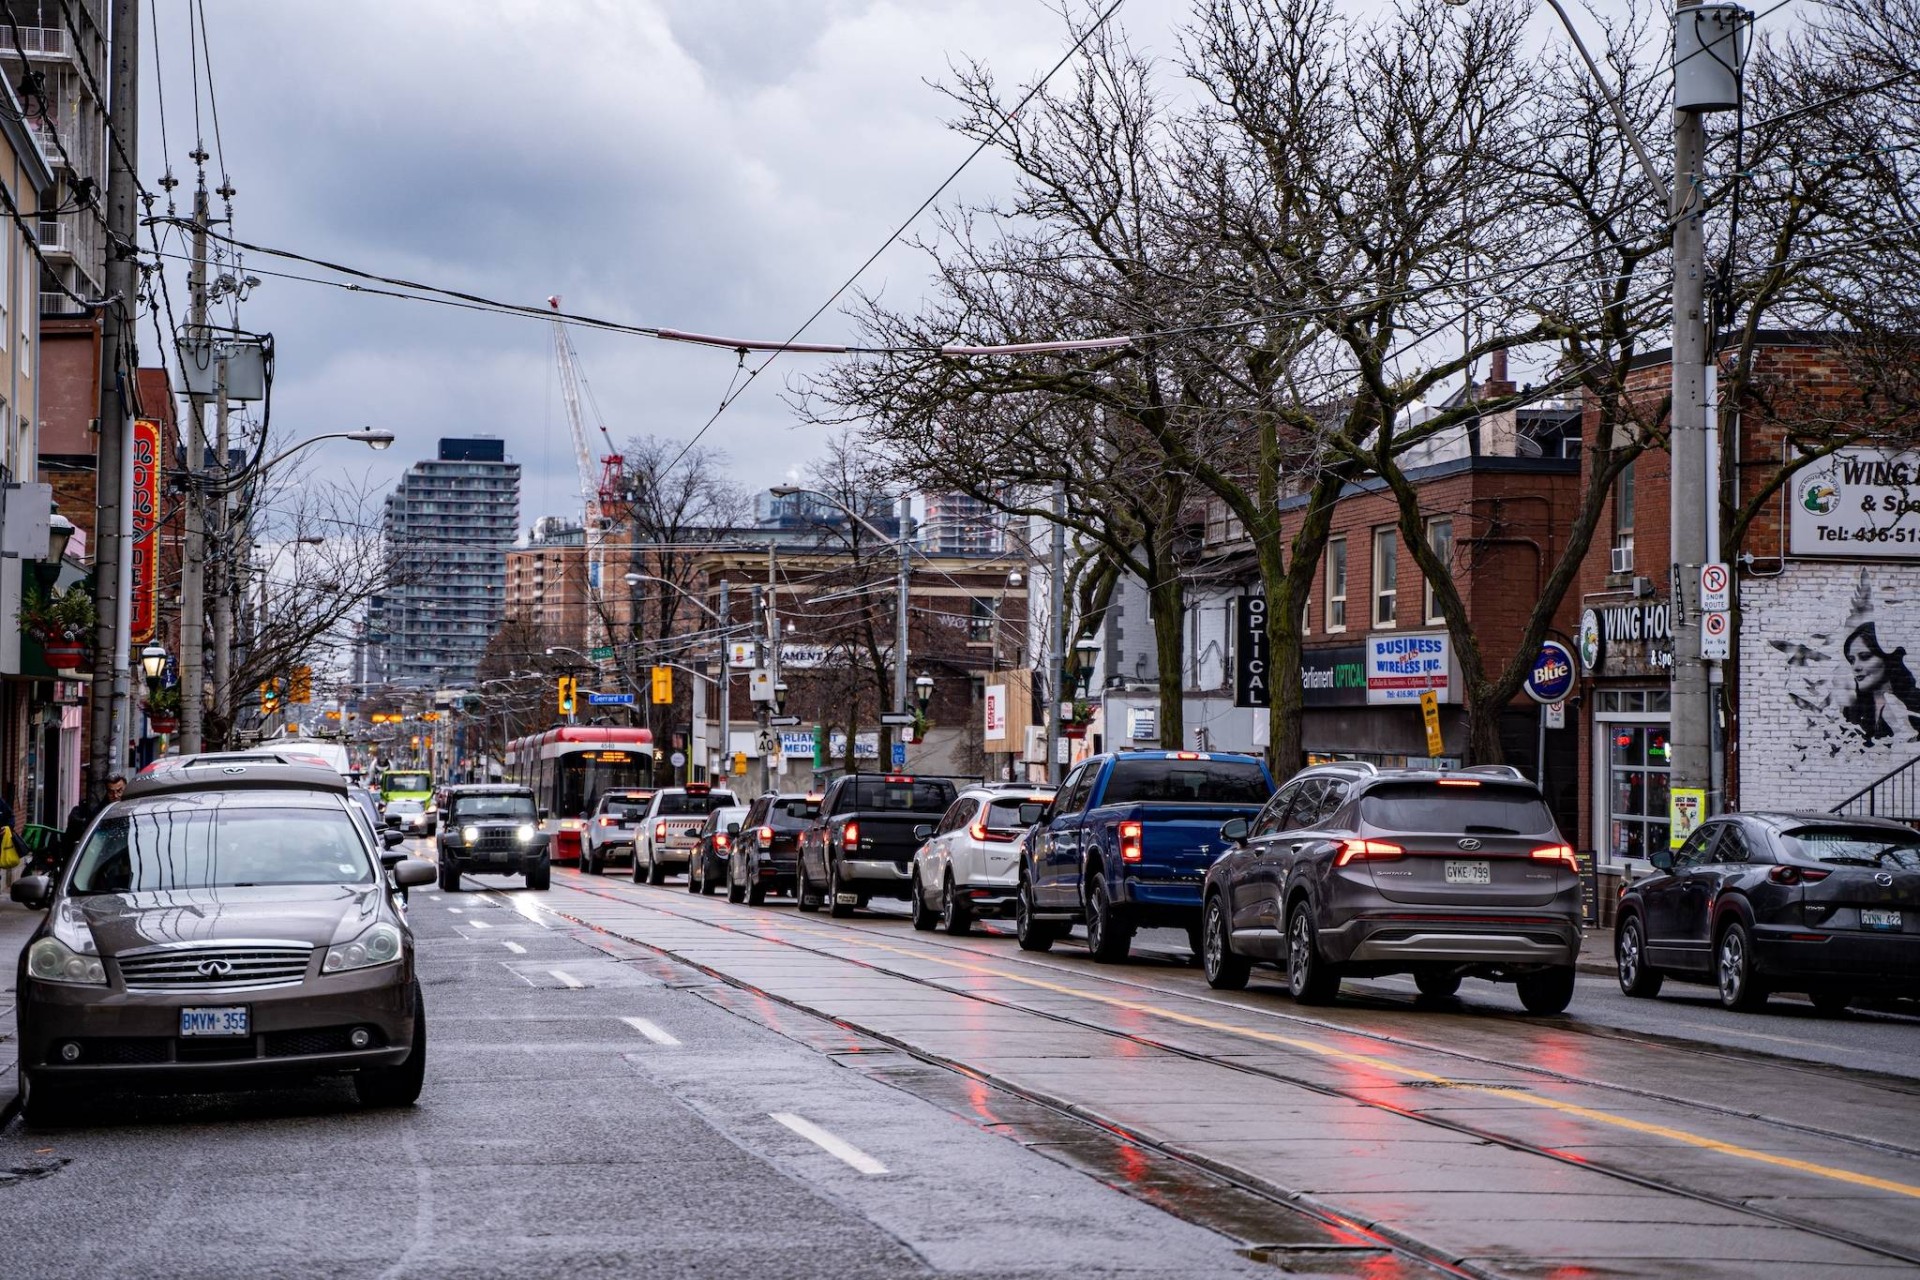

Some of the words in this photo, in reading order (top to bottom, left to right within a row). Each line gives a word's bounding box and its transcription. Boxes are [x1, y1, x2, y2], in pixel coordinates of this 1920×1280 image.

[1843, 461, 1909, 485] WING
[1861, 495, 1877, 512] &
[1817, 525, 1849, 541] Tel:
[1604, 607, 1640, 640] WING
[1644, 605, 1672, 639] HOU
[1249, 599, 1265, 704] OPTICAL
[1376, 638, 1442, 655] BUSINESS
[1376, 660, 1421, 674] WIRELESS
[1423, 659, 1442, 671] INC.
[1651, 650, 1656, 666] &
[1335, 664, 1366, 688] OPTICAL
[1534, 664, 1568, 684] Blue
[759, 740, 774, 751] 40
[1447, 866, 1468, 878] GVKE
[1472, 867, 1488, 879] 799
[183, 1013, 215, 1030] BMVM
